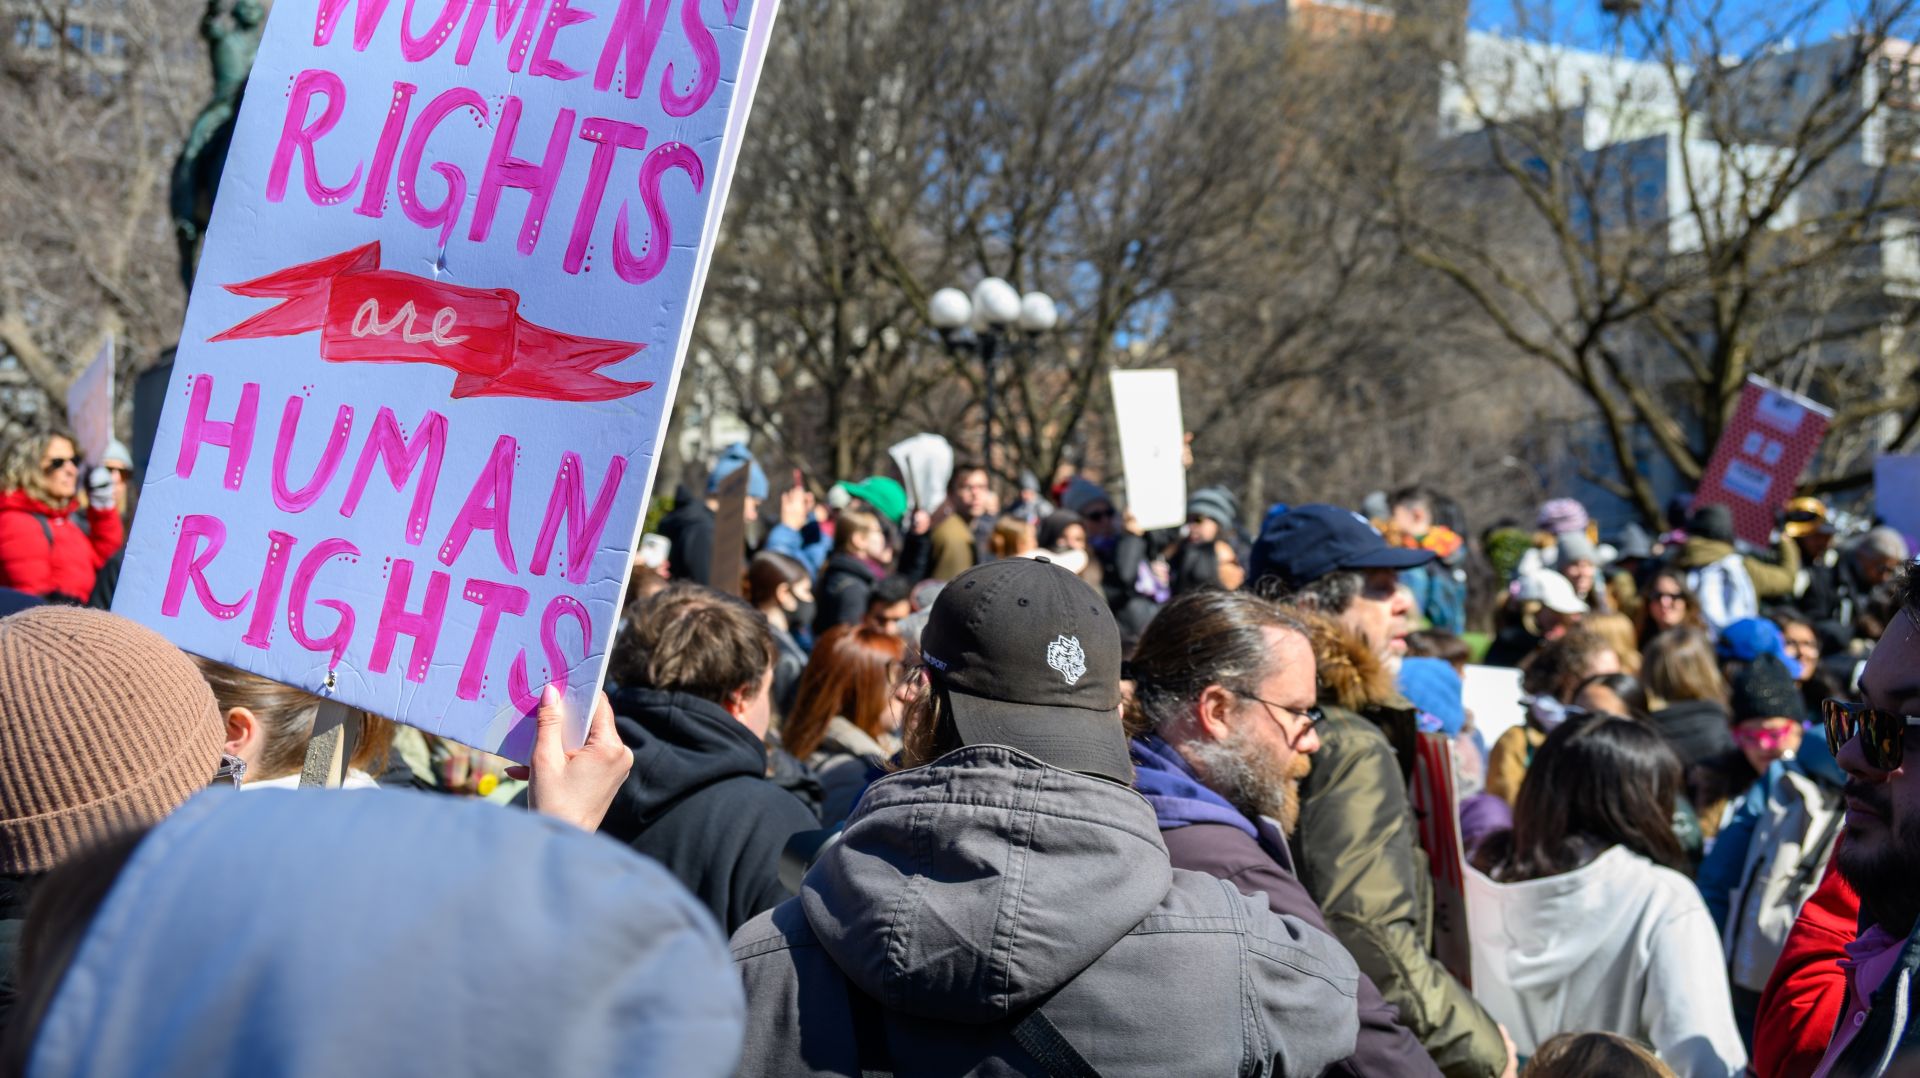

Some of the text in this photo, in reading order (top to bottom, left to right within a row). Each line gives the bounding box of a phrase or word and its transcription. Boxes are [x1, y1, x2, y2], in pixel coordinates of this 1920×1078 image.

[266, 69, 705, 284] RIGHTS
[351, 297, 467, 347] are
[176, 373, 628, 584] HUMAN
[161, 514, 593, 719] RIGHTS
